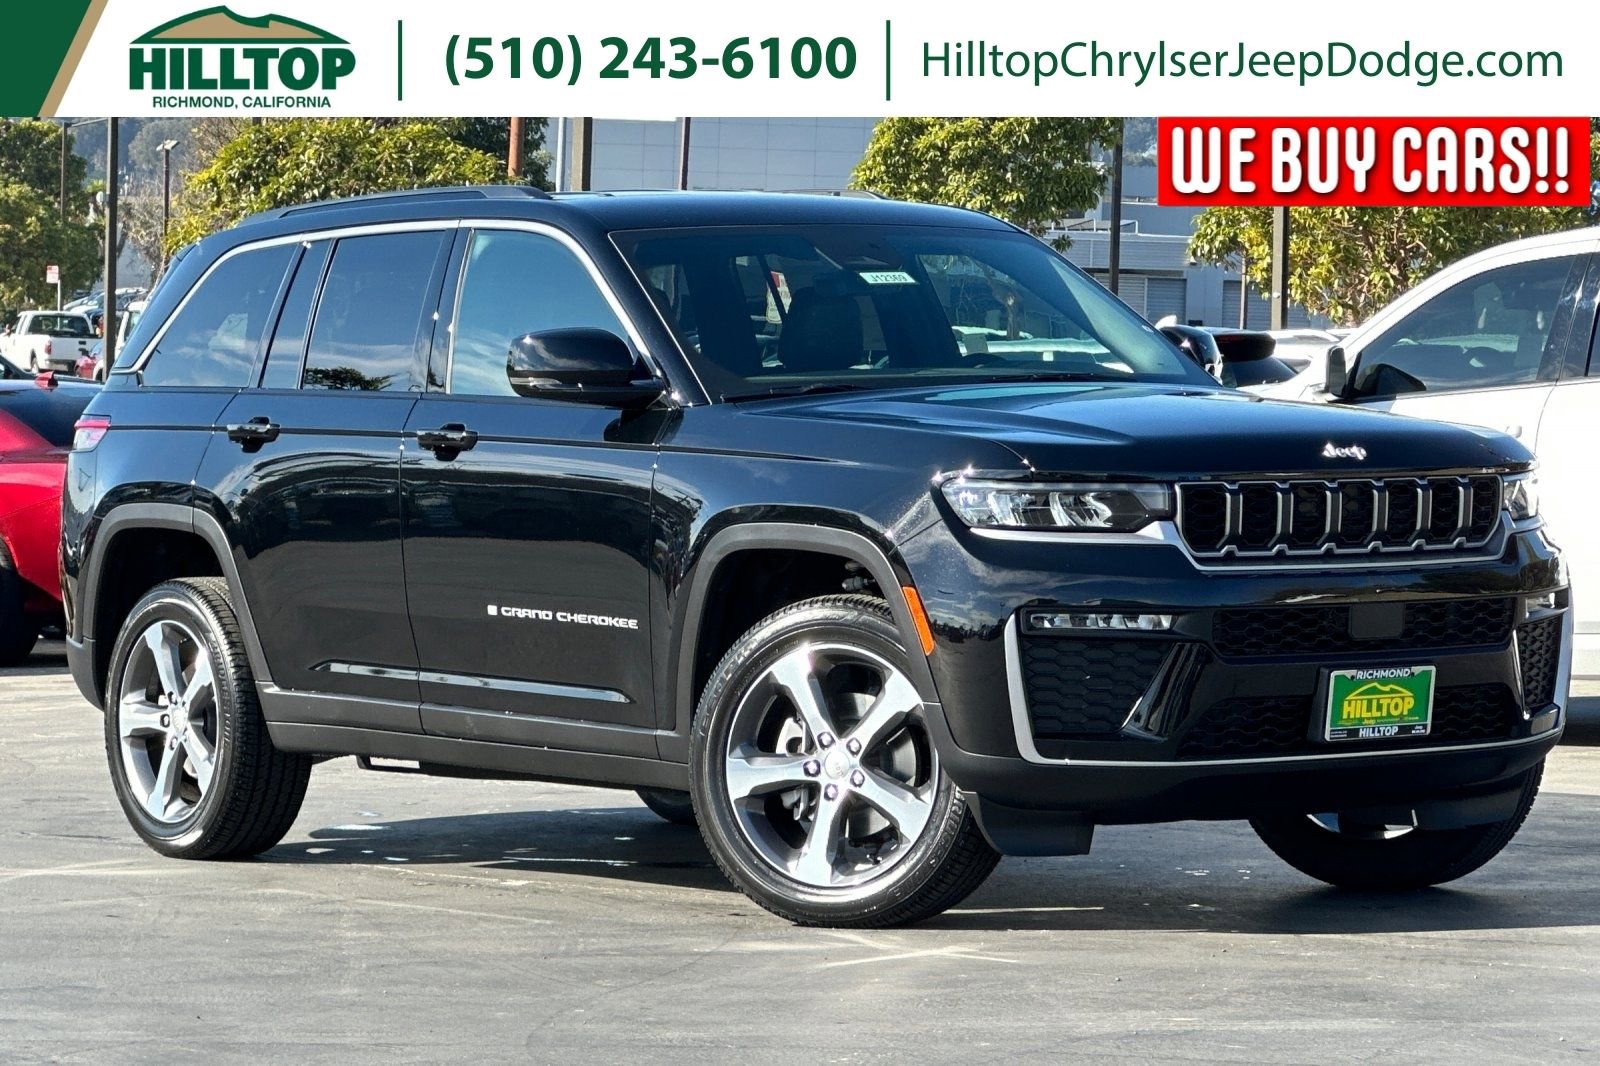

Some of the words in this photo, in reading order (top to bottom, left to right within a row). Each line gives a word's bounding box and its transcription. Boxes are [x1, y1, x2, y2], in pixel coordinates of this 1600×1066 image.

[1322, 442, 1367, 460] Jeep
[501, 606, 552, 620] GRAND
[556, 612, 639, 629] CHEROKEE
[1356, 668, 1411, 680] RICHMOND
[1343, 697, 1414, 719] HILLTOP
[1359, 726, 1399, 738] HILLTOP
